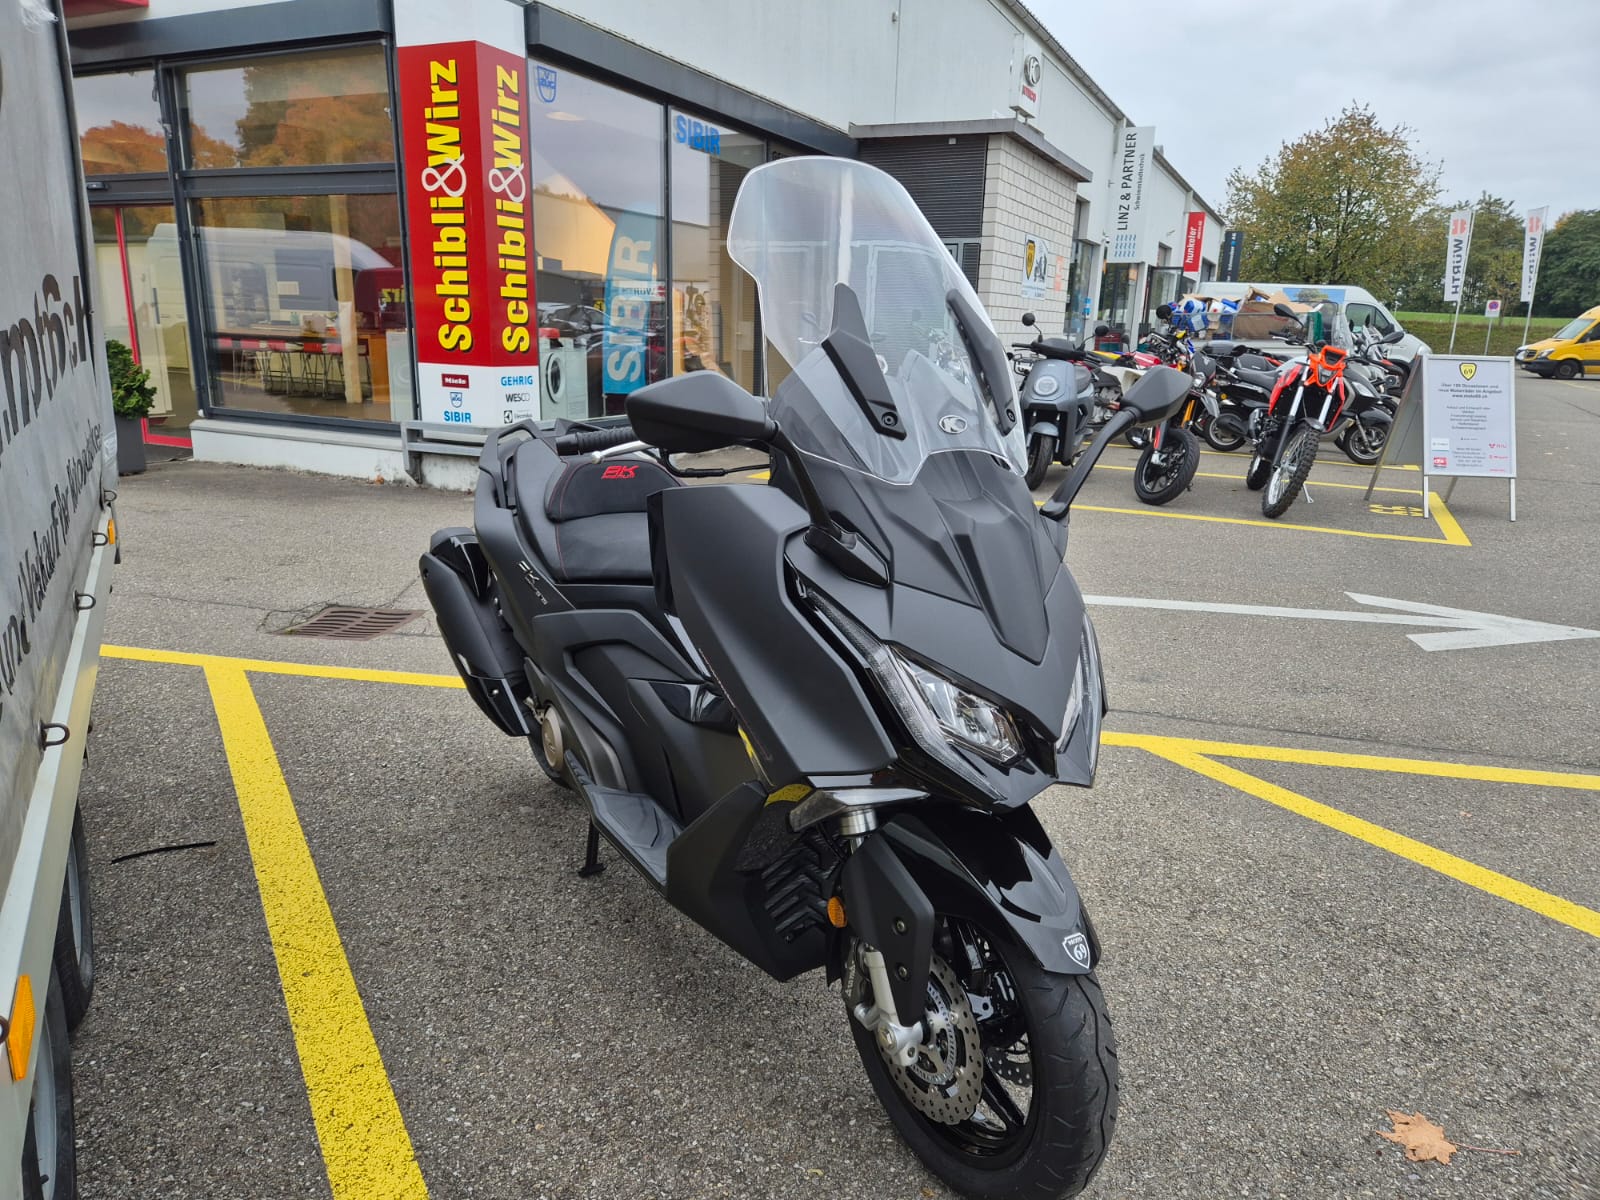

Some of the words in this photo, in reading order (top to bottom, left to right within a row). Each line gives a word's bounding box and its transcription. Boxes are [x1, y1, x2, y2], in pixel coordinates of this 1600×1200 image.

[676, 114, 721, 155] SIBIR
[1121, 132, 1138, 189] PARTNER
[1120, 193, 1131, 201] &
[1116, 204, 1131, 231] LINZ
[606, 234, 653, 382] SIBIR
[500, 375, 534, 387] GEHRIG
[443, 410, 472, 423] SIBIR
[1074, 944, 1087, 960] 69
